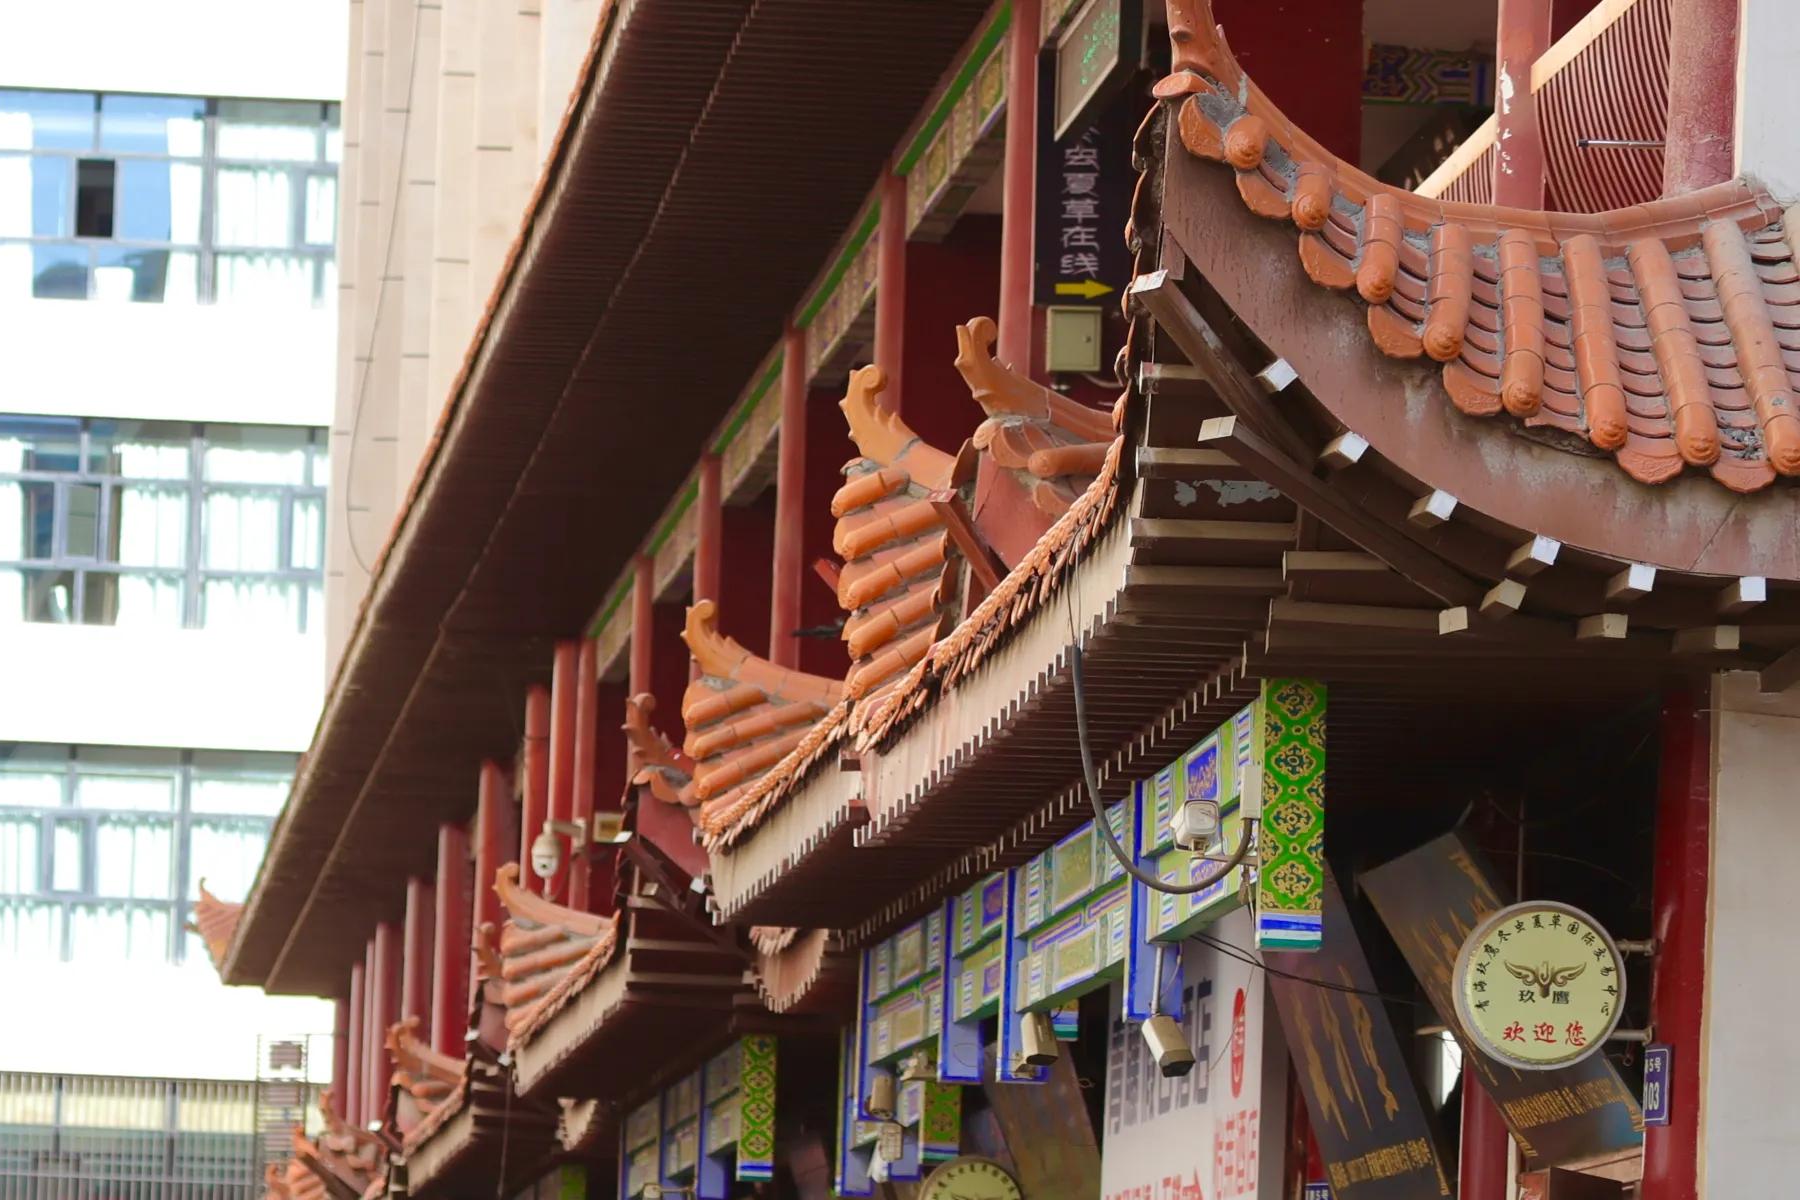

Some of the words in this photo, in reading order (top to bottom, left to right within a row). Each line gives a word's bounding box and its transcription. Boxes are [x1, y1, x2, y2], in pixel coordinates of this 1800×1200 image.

[1518, 989, 1570, 1005] 玖鹰
[1502, 1020, 1587, 1047] 欢迎您
